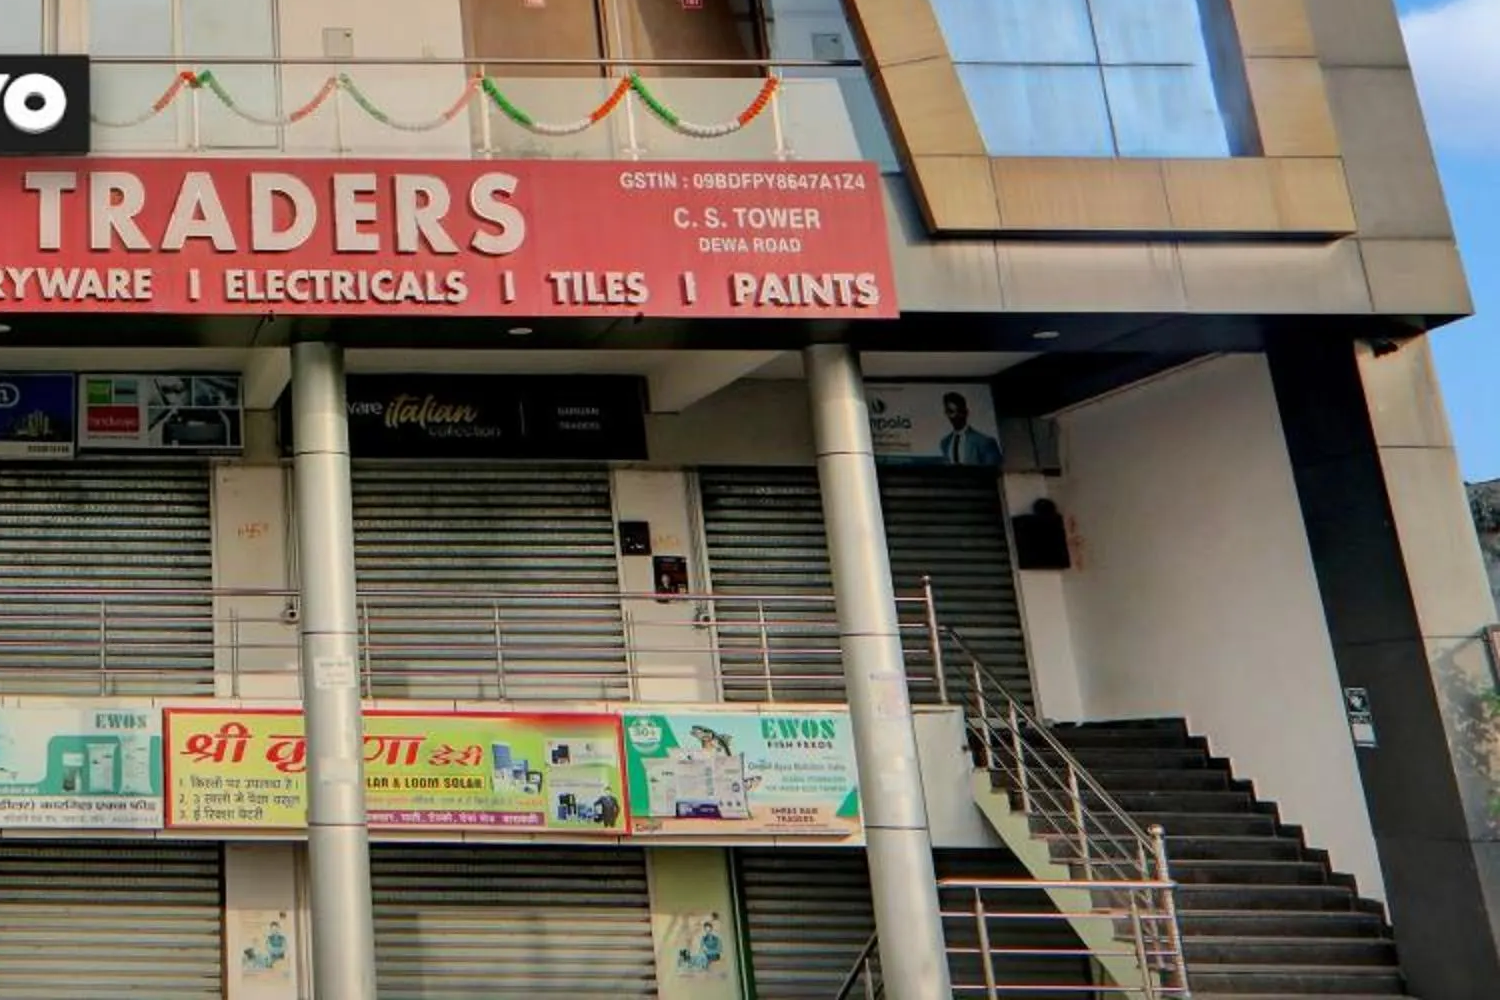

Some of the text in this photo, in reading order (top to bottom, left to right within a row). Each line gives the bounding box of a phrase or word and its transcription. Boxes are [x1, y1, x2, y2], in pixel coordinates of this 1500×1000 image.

[620, 172, 677, 189] GSTIN
[25, 171, 529, 255] TRADERS
[673, 207, 821, 229] C. S. TOWER
[699, 238, 802, 252] DEWA ROAD
[224, 269, 468, 304] ELECTRICALS
[550, 272, 649, 304] TILES
[732, 272, 880, 307] PAINTS
[384, 393, 479, 430] italian
[95, 713, 148, 729] EWOS
[760, 718, 836, 739] EWOS
[180, 721, 253, 764] श्री
[366, 777, 390, 789] LAR
[444, 777, 483, 790] SOLAR
